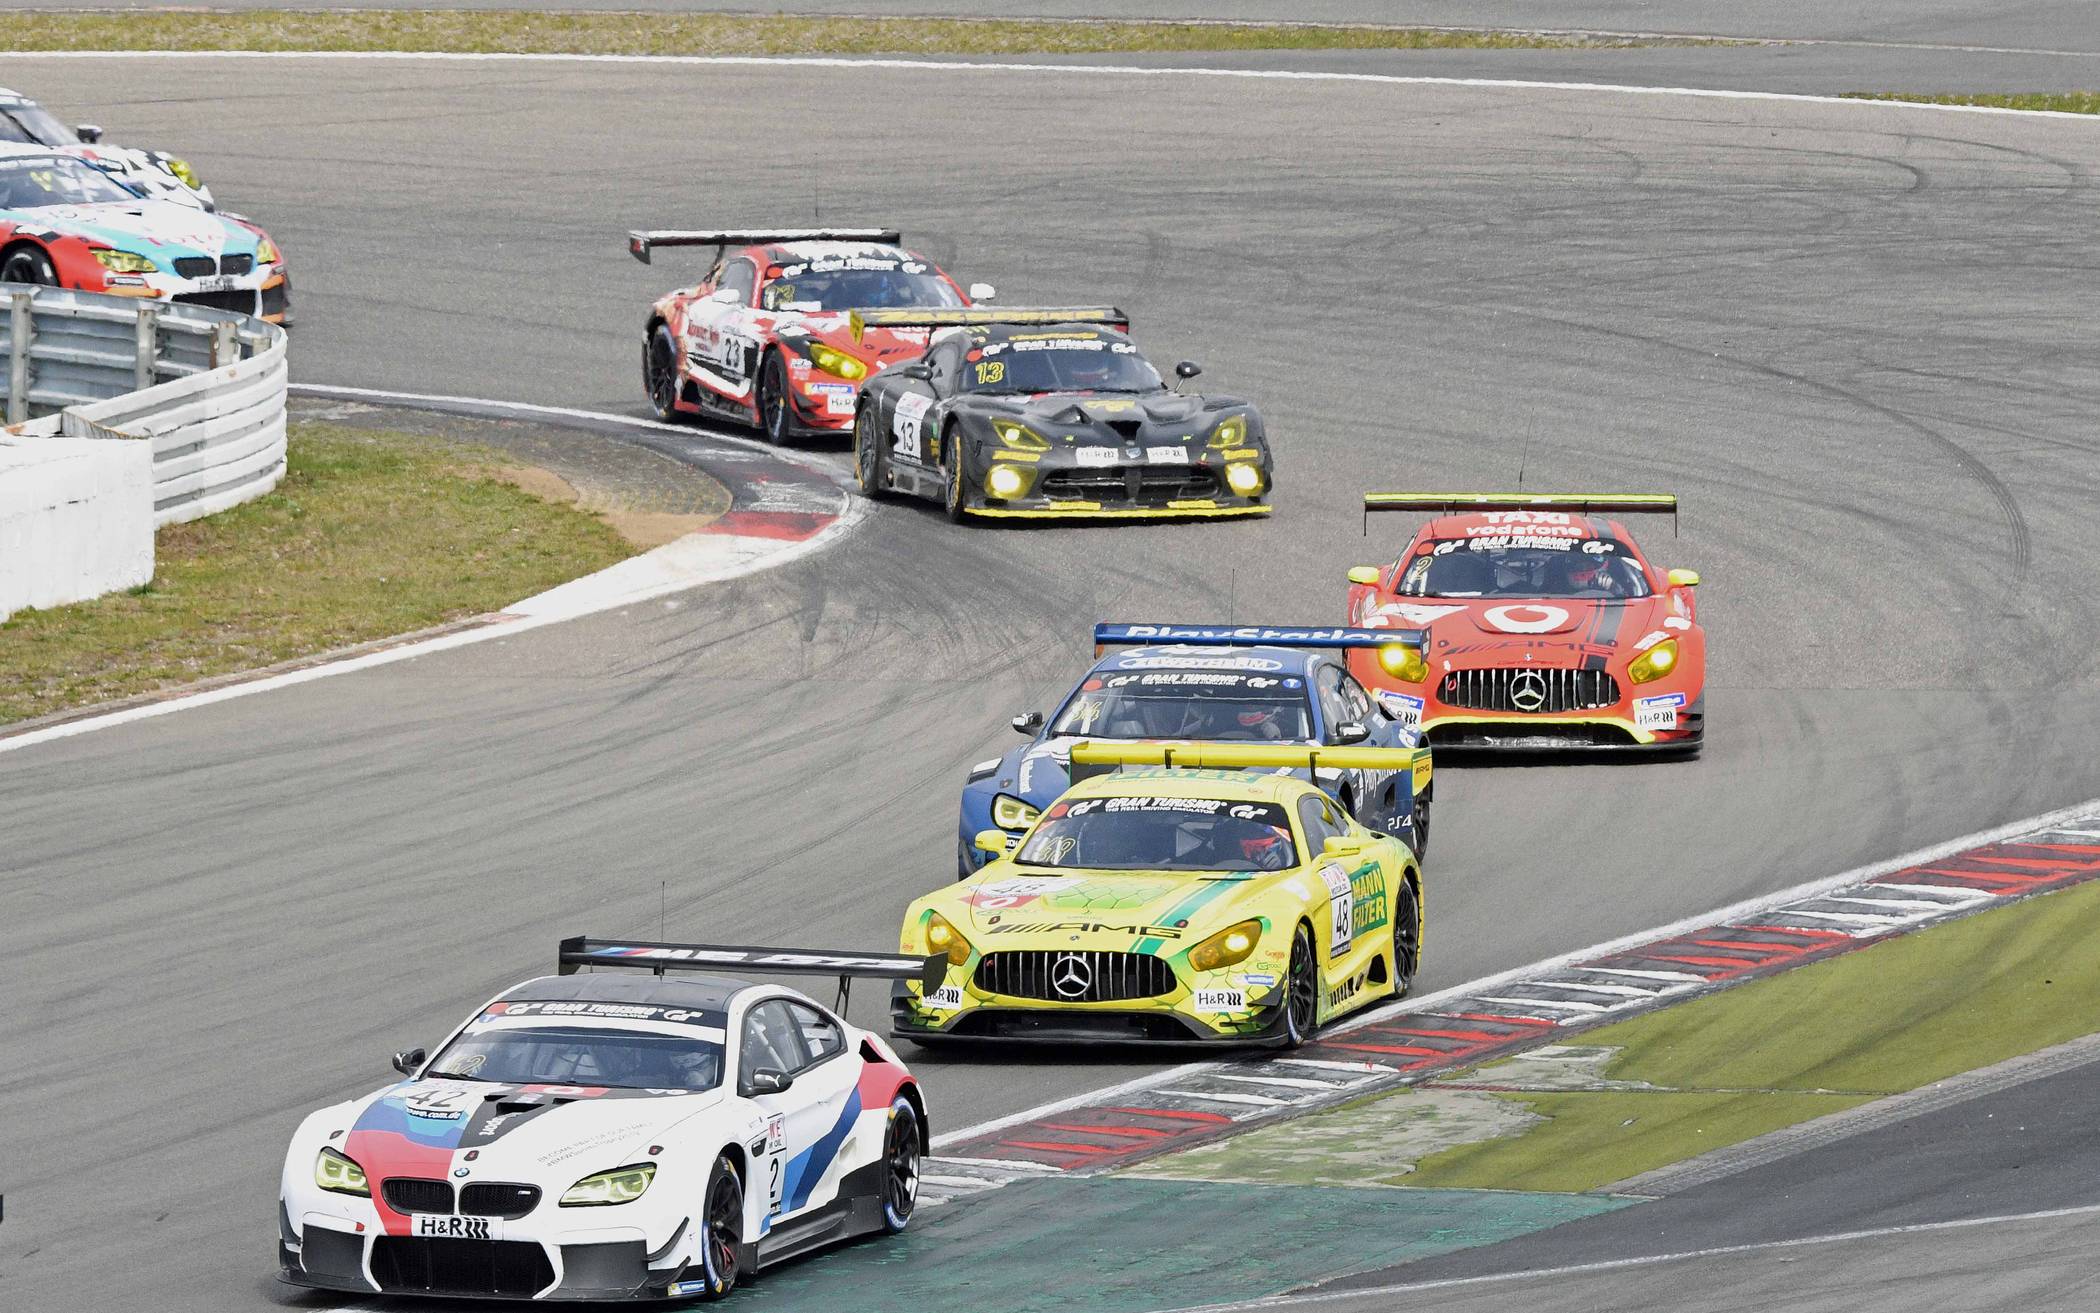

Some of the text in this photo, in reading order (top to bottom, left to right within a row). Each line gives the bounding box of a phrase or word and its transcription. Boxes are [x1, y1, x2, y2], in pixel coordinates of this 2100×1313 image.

[975, 361, 1005, 385] 13
[901, 421, 914, 452] 13
[1481, 511, 1571, 524] TAXI
[1466, 525, 1583, 536] vodafone
[1105, 798, 1222, 810] GRAN TURISMO
[1352, 867, 1385, 902] MANN
[1336, 899, 1349, 939] 48
[1353, 896, 1386, 931] FILTER
[1047, 922, 1183, 940] AMG
[1198, 992, 1225, 1006] H&R
[542, 1003, 658, 1016] GRAN TURISMO
[407, 1090, 468, 1108] 42
[420, 1216, 464, 1237] H&R
